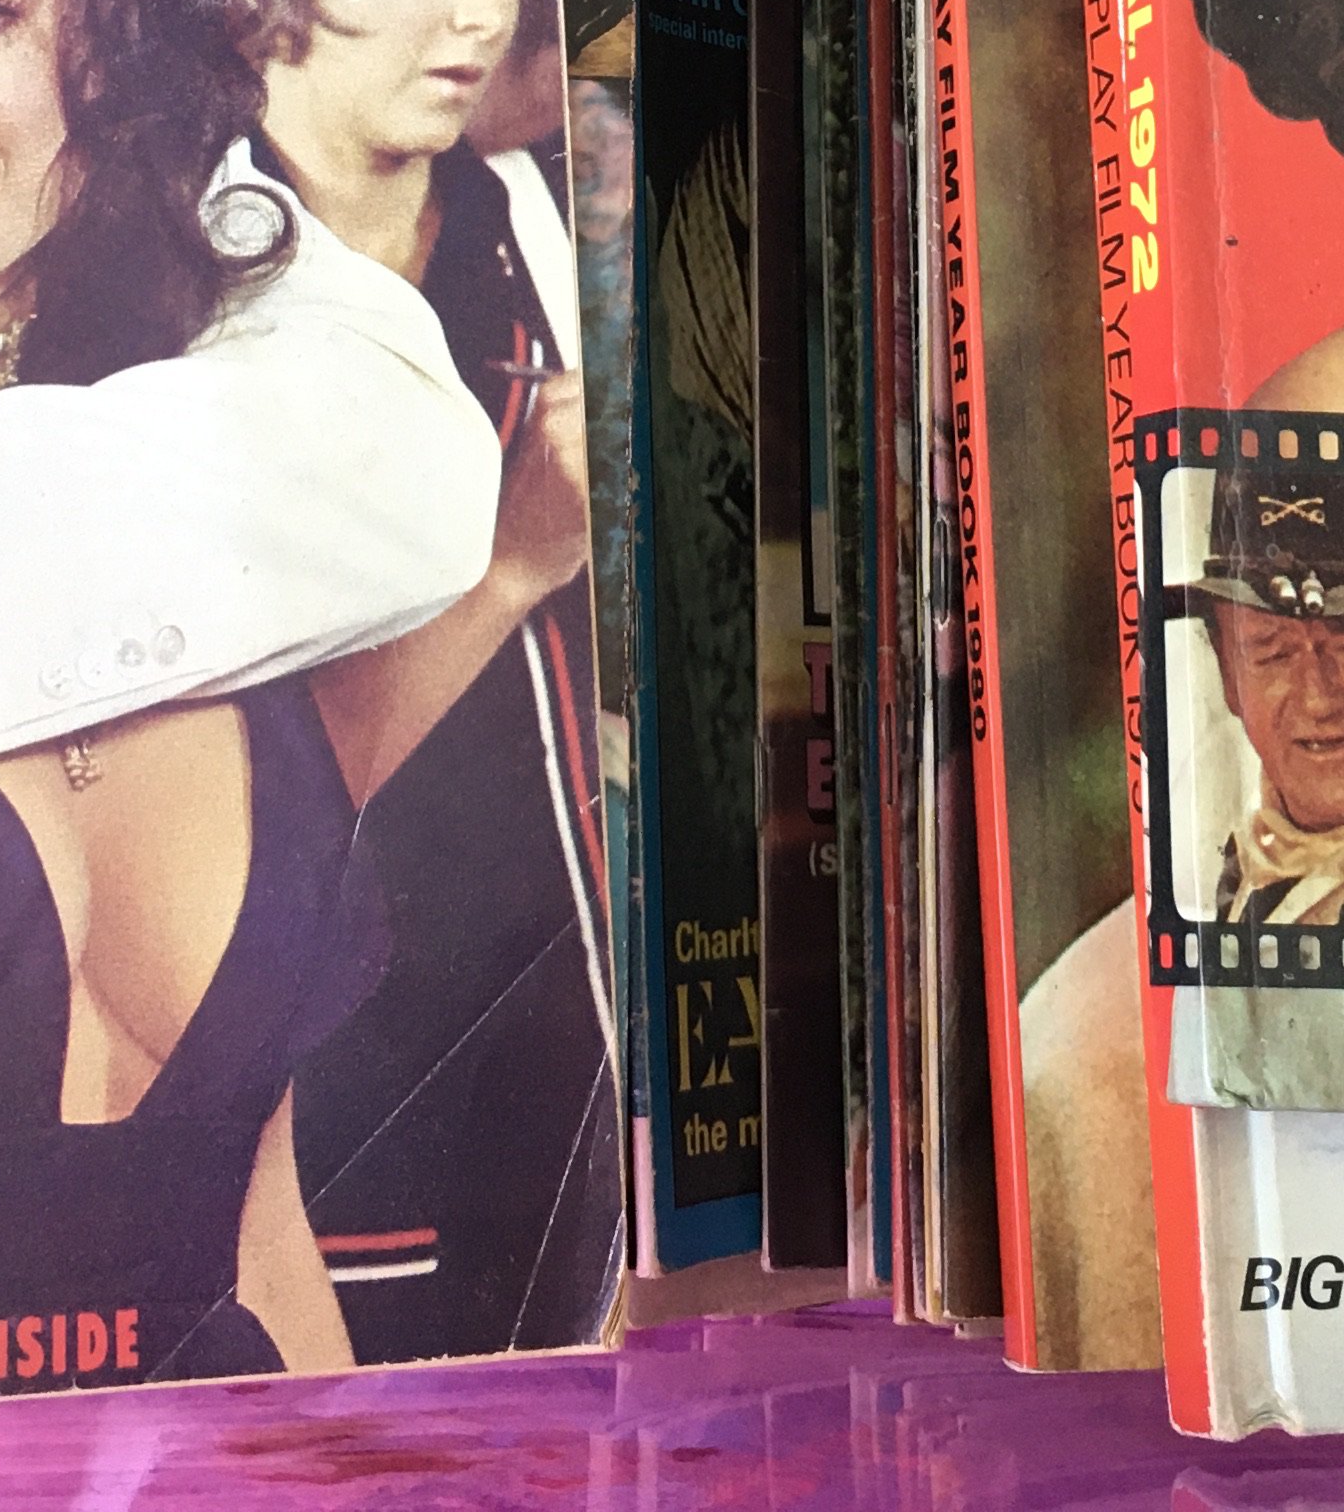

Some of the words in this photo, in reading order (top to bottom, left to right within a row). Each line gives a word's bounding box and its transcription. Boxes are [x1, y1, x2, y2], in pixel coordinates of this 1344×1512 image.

[648, 10, 698, 42] special
[939, 65, 962, 203] FILM
[1128, 77, 1159, 294] 1972
[1096, 154, 1127, 292] FILM
[945, 216, 969, 383] YEAR
[1101, 300, 1135, 472] YEAR
[956, 400, 978, 586] BOOK
[967, 600, 988, 743] 1980
[683, 1111, 729, 1157] the
